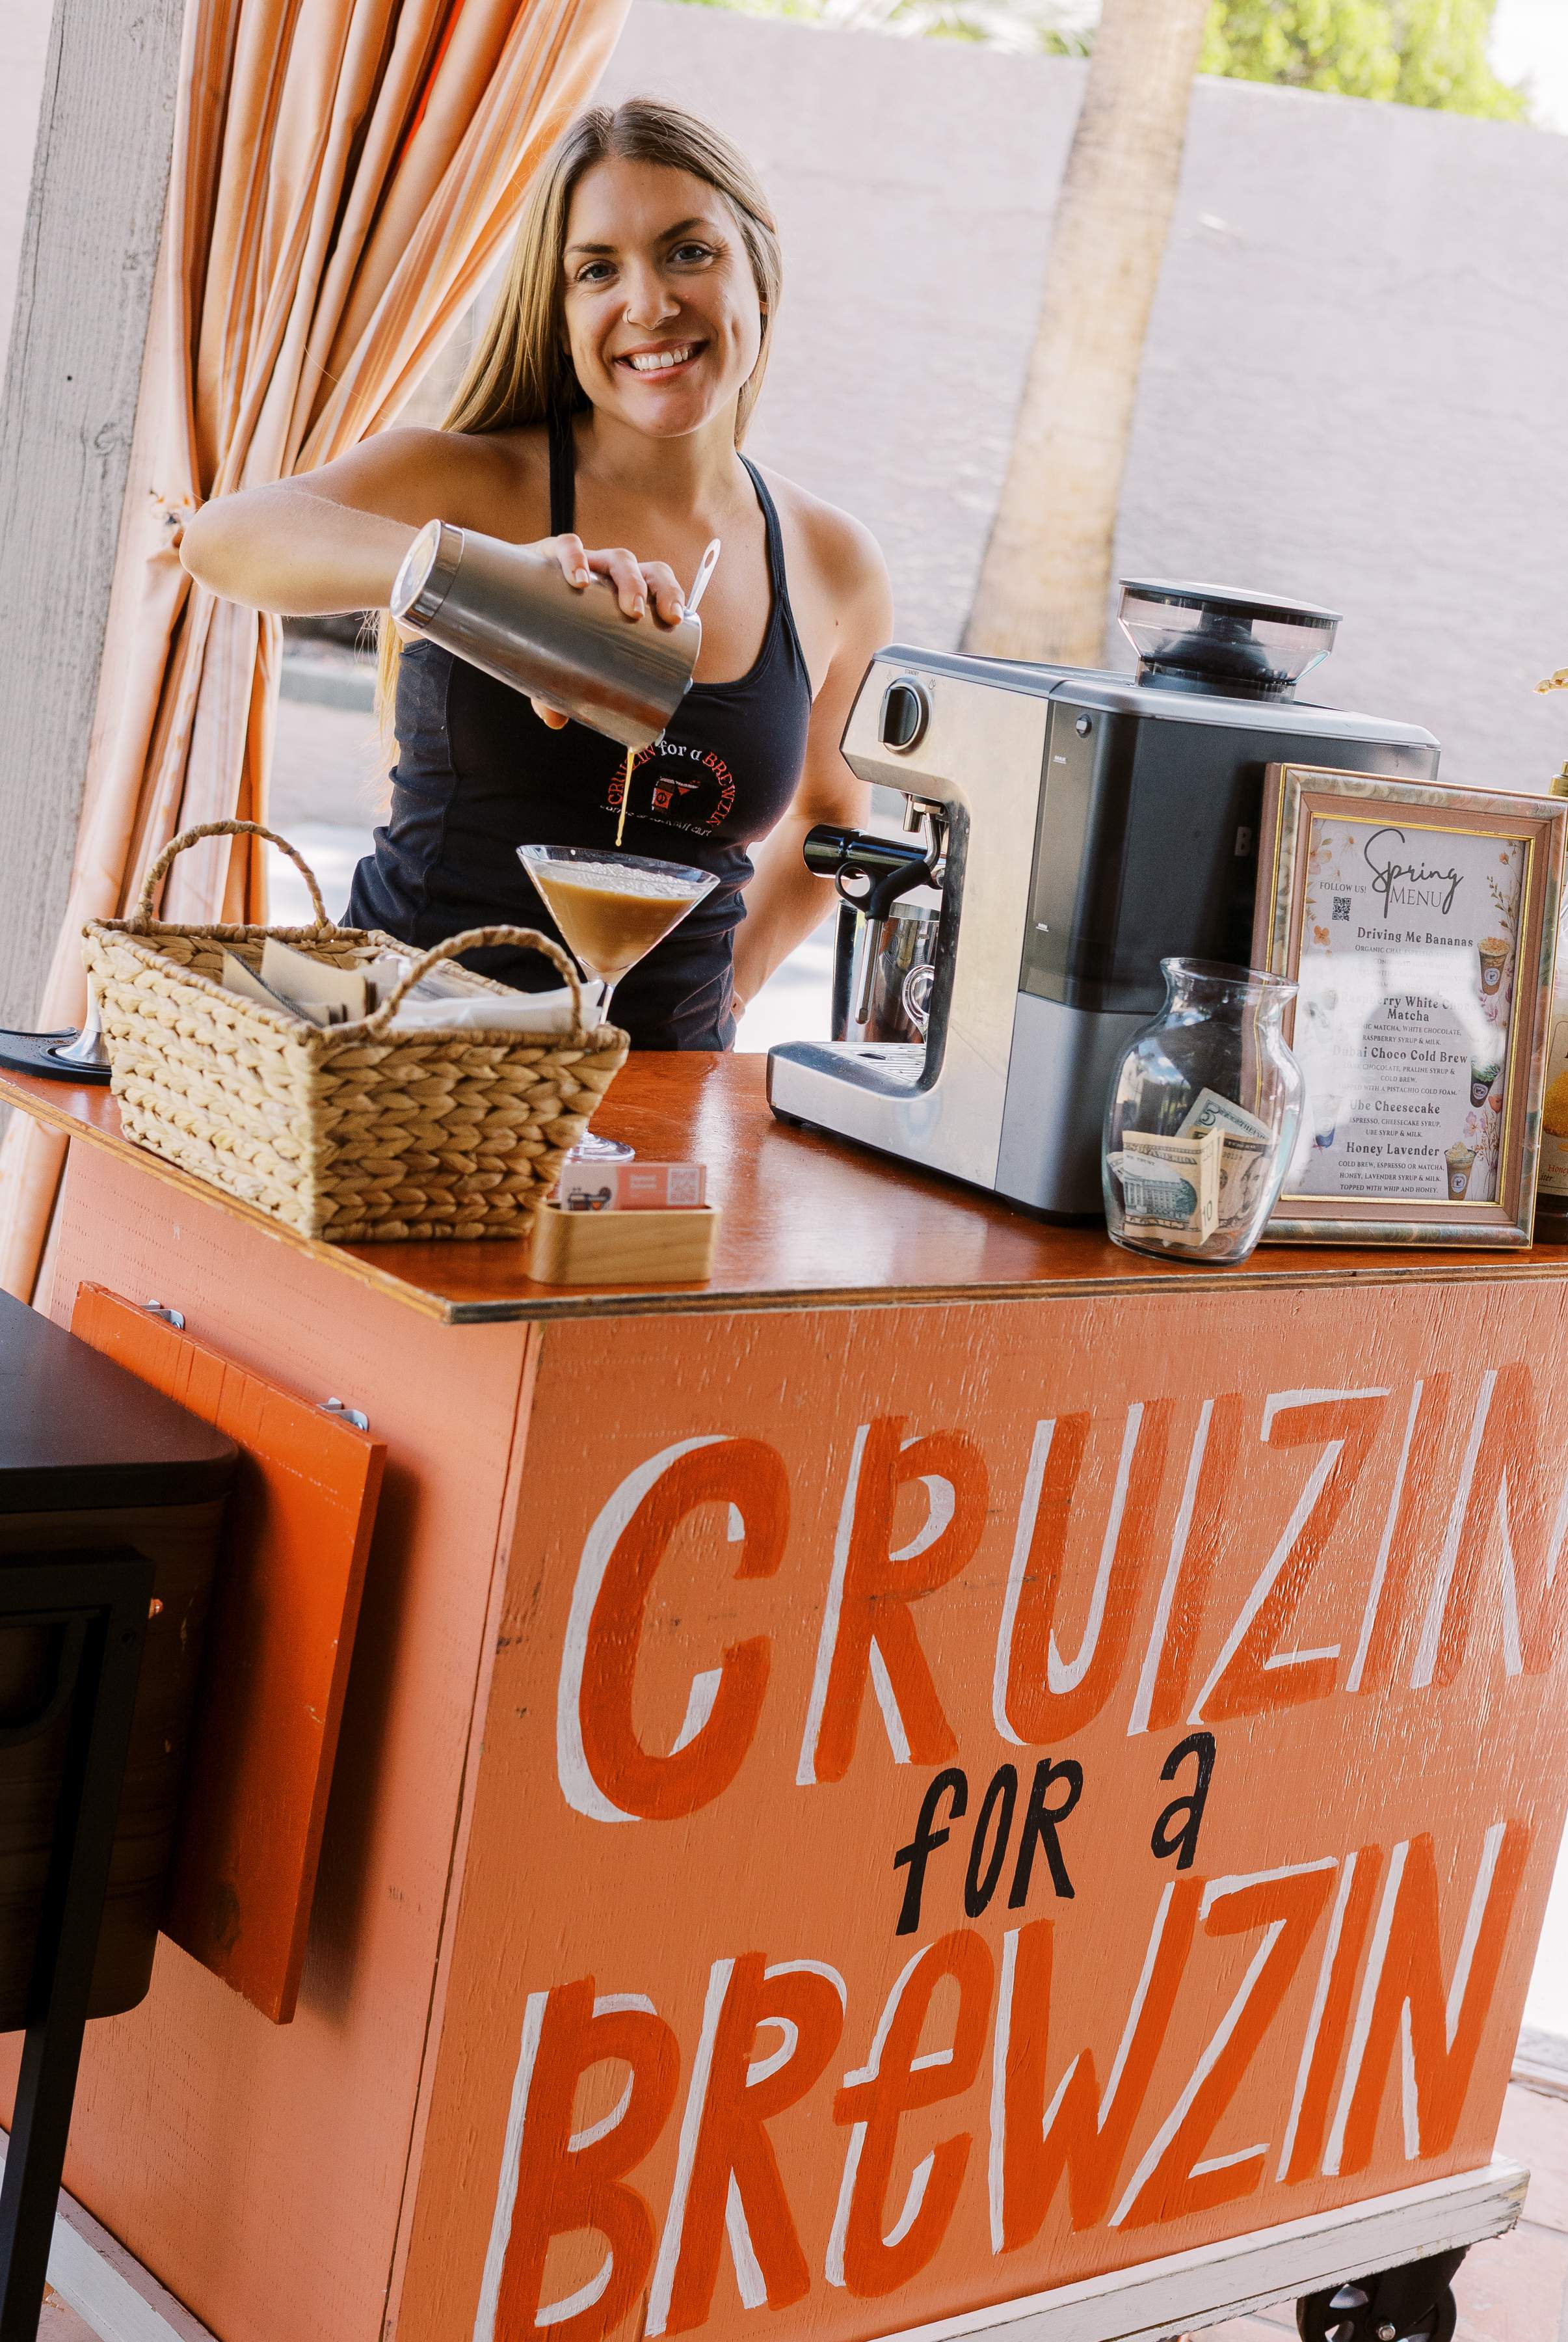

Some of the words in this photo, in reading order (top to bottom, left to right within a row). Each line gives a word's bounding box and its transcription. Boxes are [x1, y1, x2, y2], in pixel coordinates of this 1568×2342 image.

[658, 740, 687, 757] for
[689, 749, 702, 761] a
[702, 751, 736, 827] BREWZIN
[1364, 828, 1464, 919] Spring
[1320, 882, 1352, 892] FOLLOW
[1355, 885, 1366, 893] US!
[1389, 885, 1442, 908] MENU
[1357, 926, 1402, 943] Driving
[1405, 930, 1422, 943] Me
[1425, 933, 1473, 948] Bananas
[1405, 995, 1439, 1009] White
[1387, 1008, 1429, 1022] Matcha
[1374, 1024, 1401, 1032] MATCHA,
[1402, 1025, 1422, 1034] WHITE
[1424, 1027, 1462, 1036] CHOCOLATE,
[1371, 1046, 1407, 1060] Choco
[1411, 1049, 1436, 1062] Cold
[1440, 1051, 1468, 1064] Brew
[1199, 1102, 1219, 1126] 5
[1349, 1098, 1371, 1111] Ube
[1374, 1100, 1441, 1115] Cheesecake
[1349, 1117, 1380, 1125] ESPRESSO,
[1346, 1141, 1383, 1157] Honey
[1387, 1143, 1440, 1157] Lavender
[556, 1362, 1568, 1822] CRUIZIN
[1150, 1731, 1216, 1870] a
